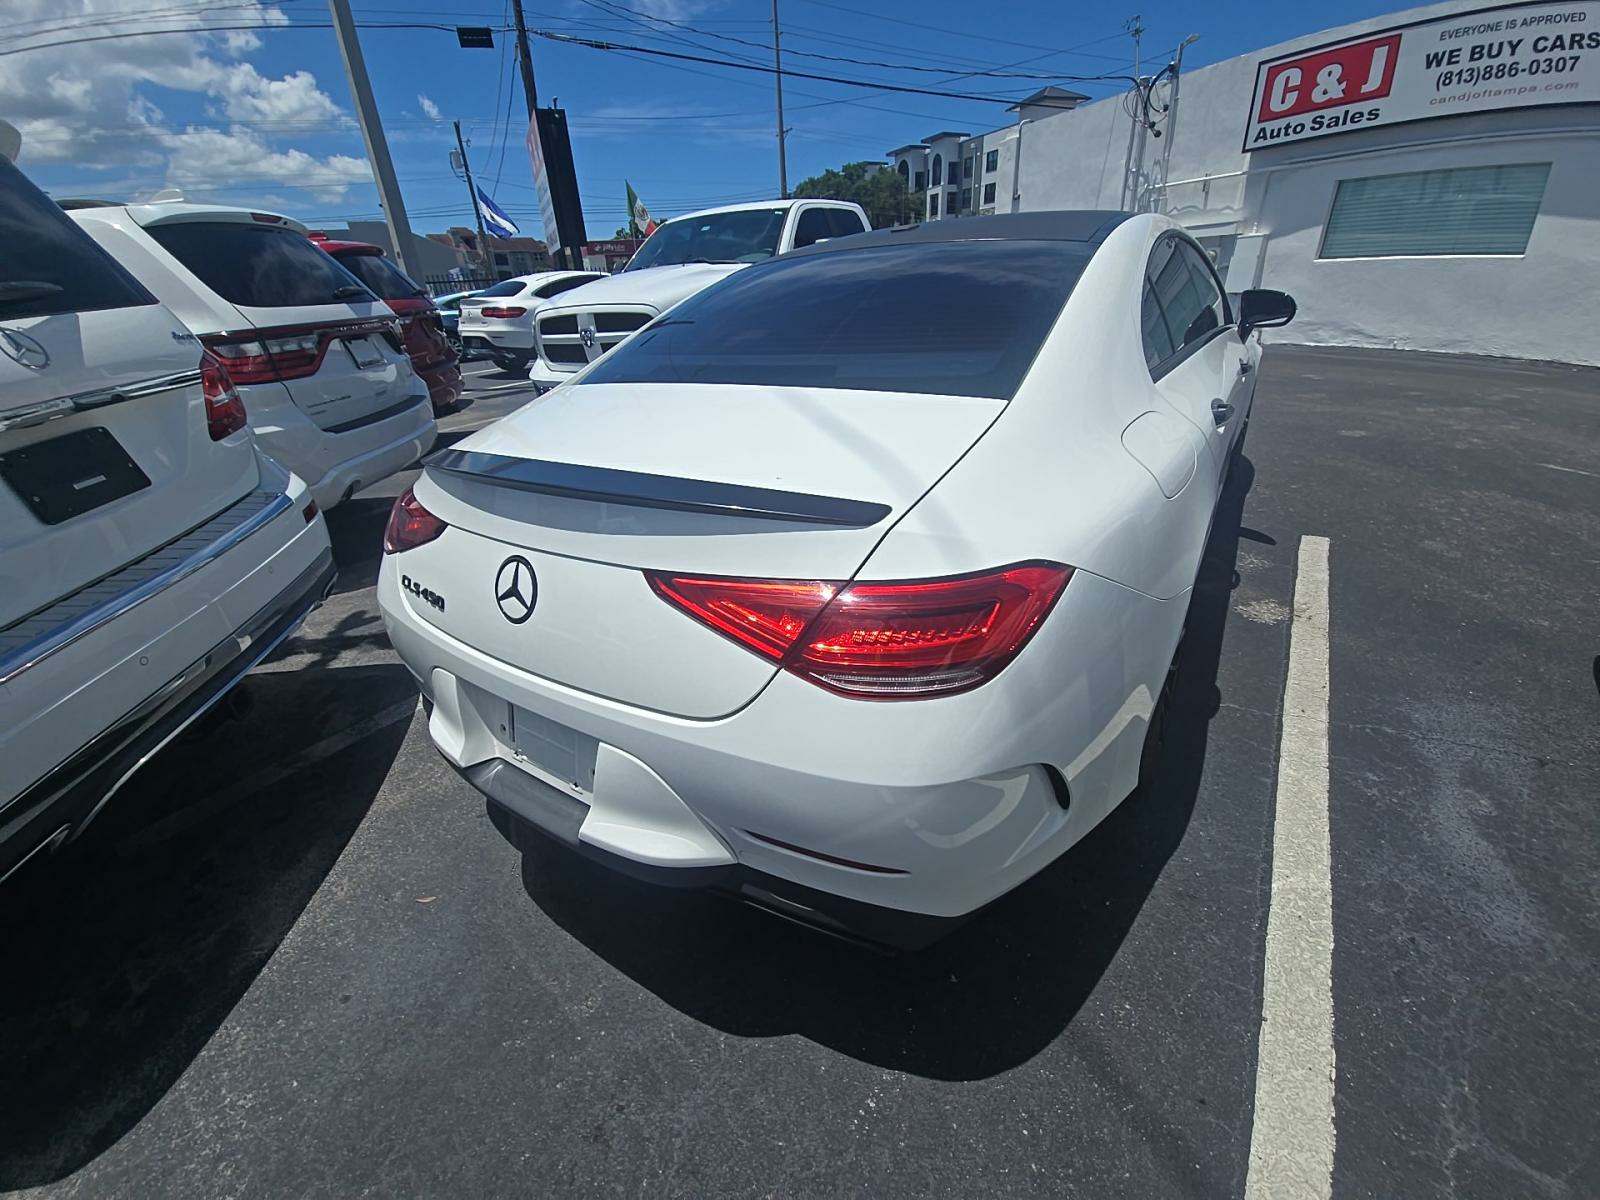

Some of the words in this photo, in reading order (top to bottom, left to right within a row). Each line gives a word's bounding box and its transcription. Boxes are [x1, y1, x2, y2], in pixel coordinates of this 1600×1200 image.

[1440, 21, 1502, 41] EVERYONE
[1505, 19, 1518, 30] IS
[1519, 12, 1587, 28] APPROVED
[1425, 48, 1463, 70] WE
[1468, 38, 1525, 63] BUY
[1532, 32, 1600, 54] CARS
[1269, 67, 1303, 113] C
[1311, 63, 1348, 103] &
[1360, 45, 1390, 94] J
[1436, 55, 1581, 91] (813)886-0307
[1429, 81, 1580, 106] candjoftampa.com
[1253, 121, 1306, 143] Auto
[1309, 107, 1381, 132] Sales
